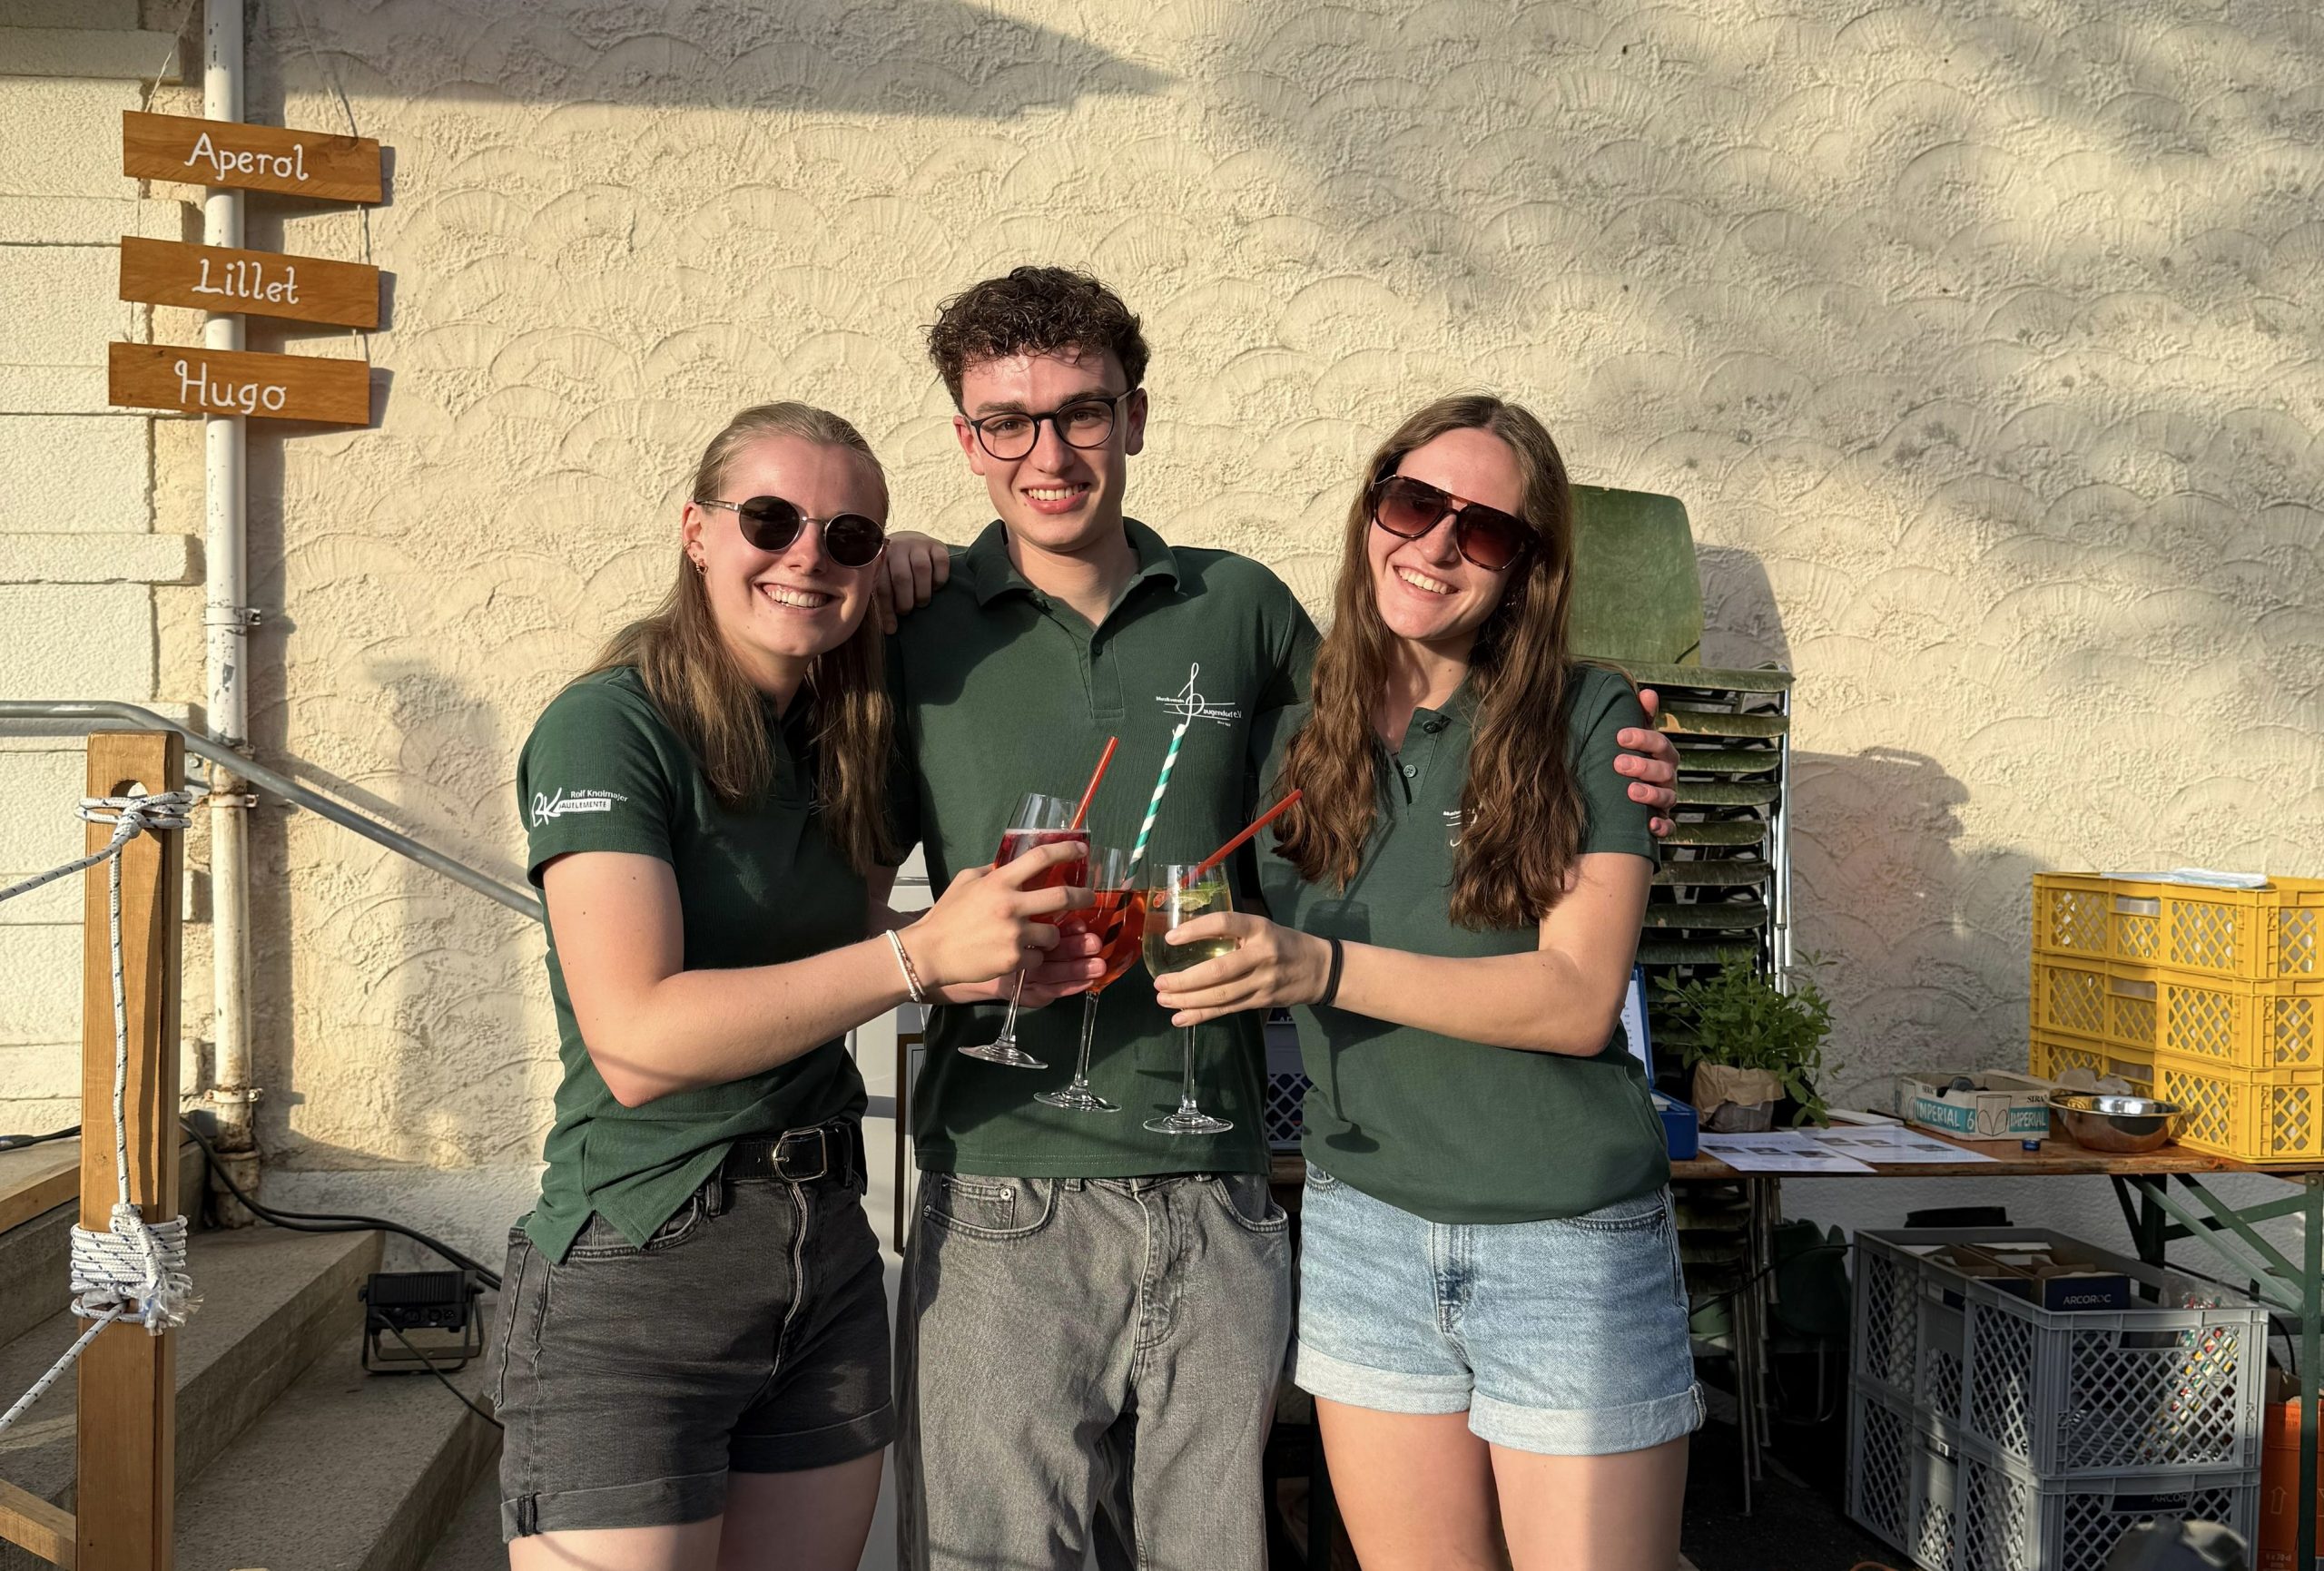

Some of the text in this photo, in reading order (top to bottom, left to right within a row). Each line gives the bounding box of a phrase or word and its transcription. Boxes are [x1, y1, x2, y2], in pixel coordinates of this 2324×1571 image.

[184, 133, 310, 182] Aperol
[192, 258, 300, 305] Lillet
[174, 360, 288, 415] Hugo
[570, 789, 586, 799] Rolf
[1916, 1101, 1960, 1129] IMPERIAL
[1966, 1110, 1975, 1131] 6
[2010, 1111, 2047, 1128] IMPERIAL
[2063, 1294, 2112, 1305] ARCOROC
